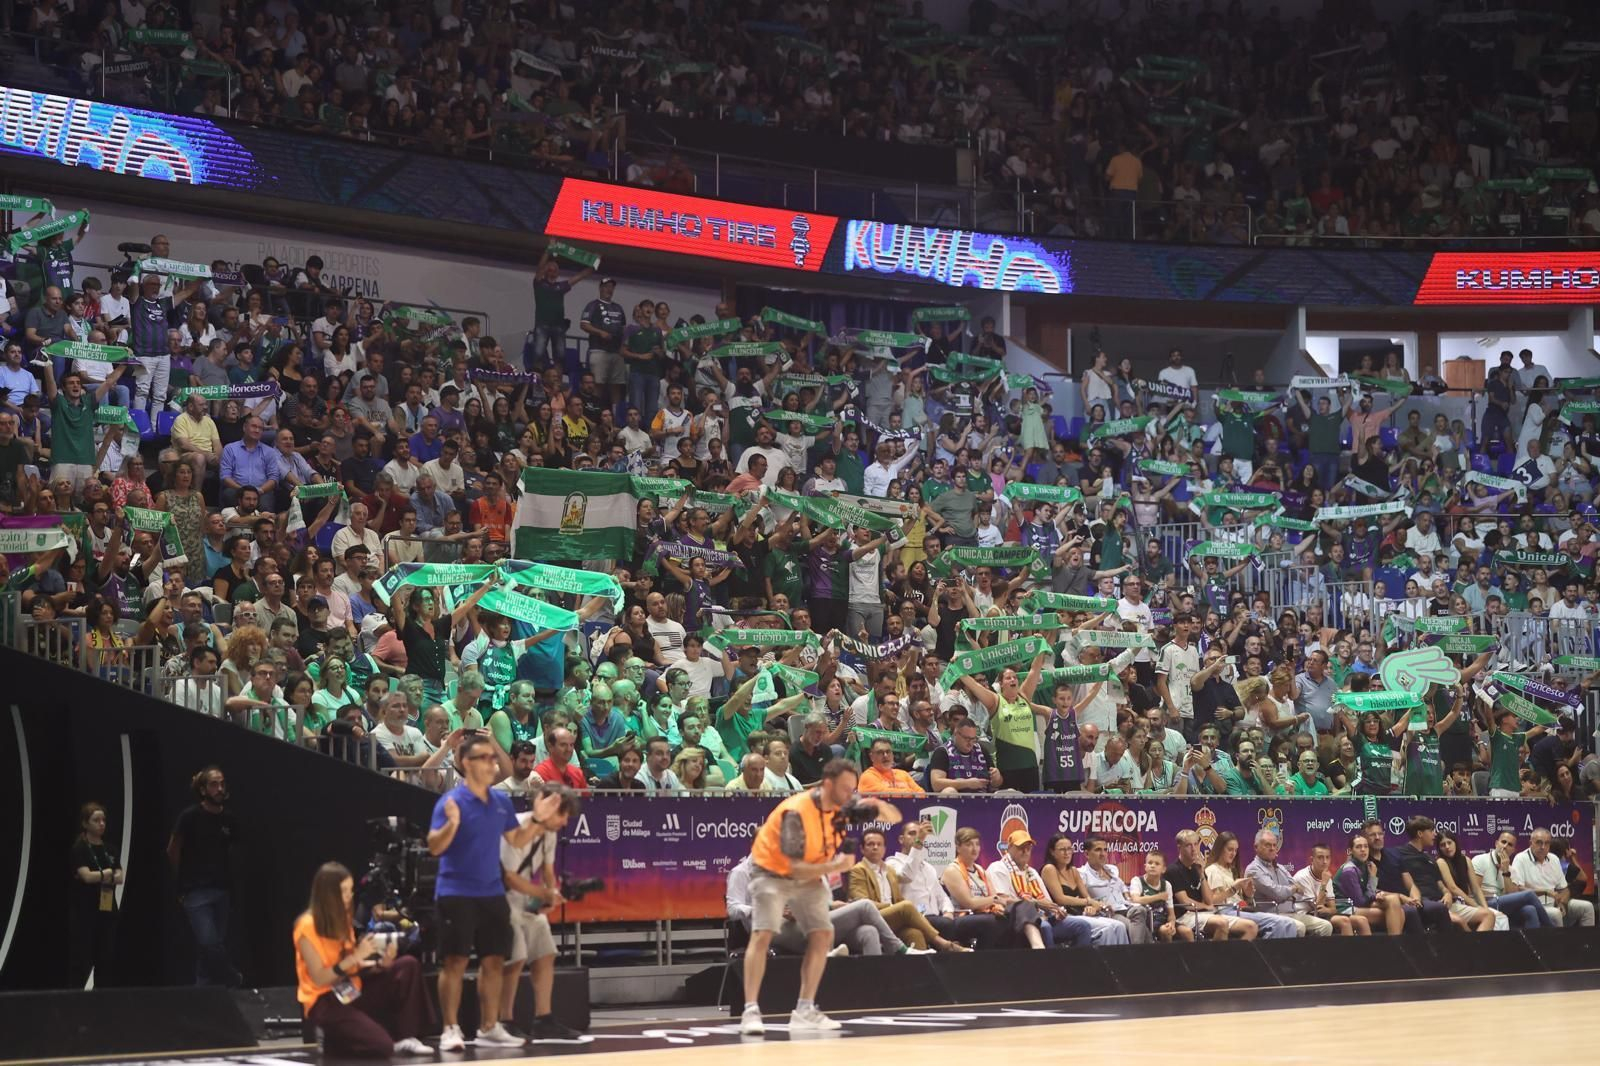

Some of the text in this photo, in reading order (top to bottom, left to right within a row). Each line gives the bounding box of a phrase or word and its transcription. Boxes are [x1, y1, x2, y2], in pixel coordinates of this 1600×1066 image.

[582, 199, 777, 248] KUMHO TIRE
[845, 219, 1061, 294] KUMHO
[1456, 267, 1600, 290] KUMHO
[64, 348, 108, 360] BALONCESTO
[185, 384, 218, 396] Unicaja
[219, 383, 271, 394] Baloncesto
[1148, 381, 1191, 397] UNICAJA
[1516, 467, 1532, 484] 3
[838, 500, 865, 516] UNICAJA
[829, 504, 869, 527] BALONCESTO
[958, 549, 993, 559] UNICAJA
[1517, 551, 1567, 563] Unicaja
[434, 563, 467, 574] UNICAJA
[543, 567, 576, 580] UNICAJA
[427, 573, 473, 584] BALONCESTO
[534, 575, 583, 590] BALONCESTO
[506, 592, 540, 610] UNICAJA
[1061, 598, 1096, 609] histórico
[496, 600, 547, 623] BALONCESTO
[853, 634, 911, 658] UNICAJA
[980, 643, 1019, 661] Unicaja
[493, 660, 513, 670] Unicaja
[981, 650, 1023, 669] histórico
[1370, 699, 1408, 709] histórico
[1060, 755, 1075, 768] 55
[622, 819, 643, 827] Ciudad
[1058, 809, 1158, 832] SUPERCOPA
[1306, 820, 1331, 832] pelayo
[622, 829, 651, 838] de Málaga
[1550, 820, 1575, 838] acb
[1107, 840, 1159, 852] MÁLAGA 2025
[713, 855, 731, 866] renfe
[927, 849, 948, 859] Unicaja
[622, 858, 646, 869] Wilson
